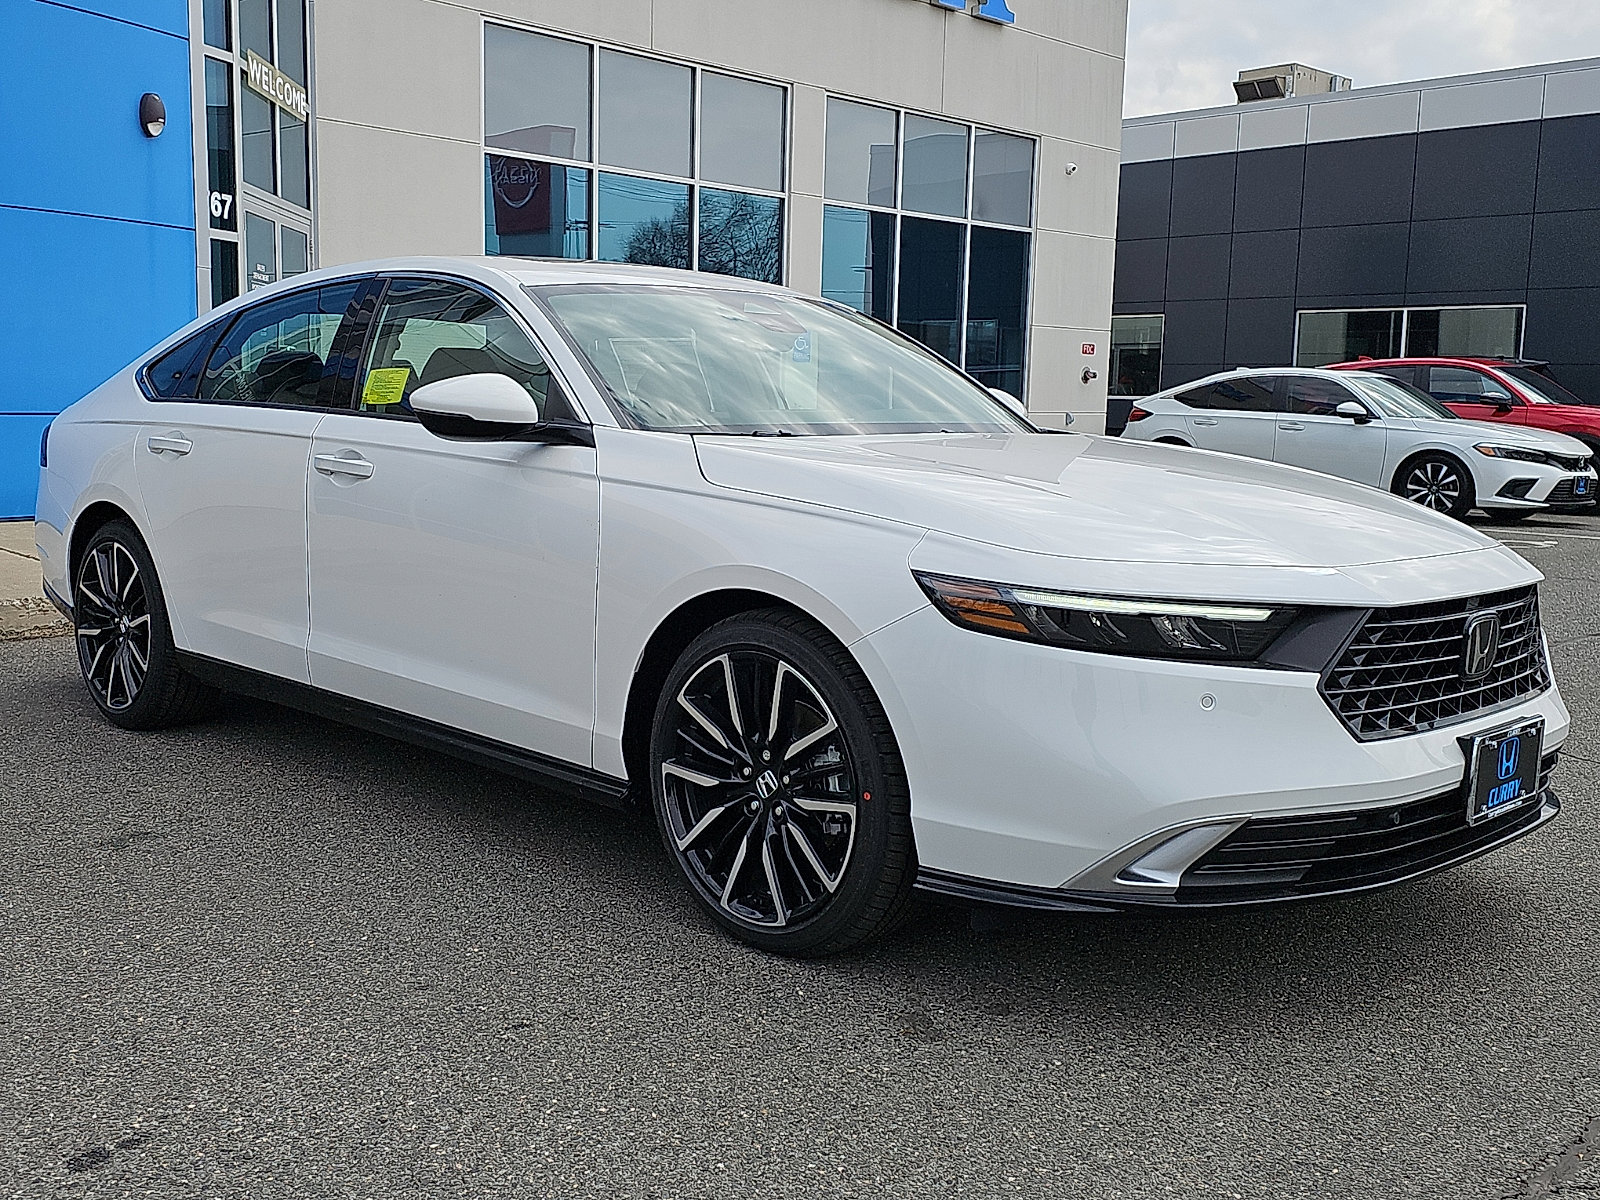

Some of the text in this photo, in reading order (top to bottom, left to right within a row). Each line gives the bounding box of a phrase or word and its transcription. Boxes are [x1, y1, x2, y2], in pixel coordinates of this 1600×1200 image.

[248, 55, 306, 117] WELCOME
[208, 190, 233, 219] 67
[1083, 345, 1094, 354] FDC
[1488, 778, 1522, 808] CURRY
